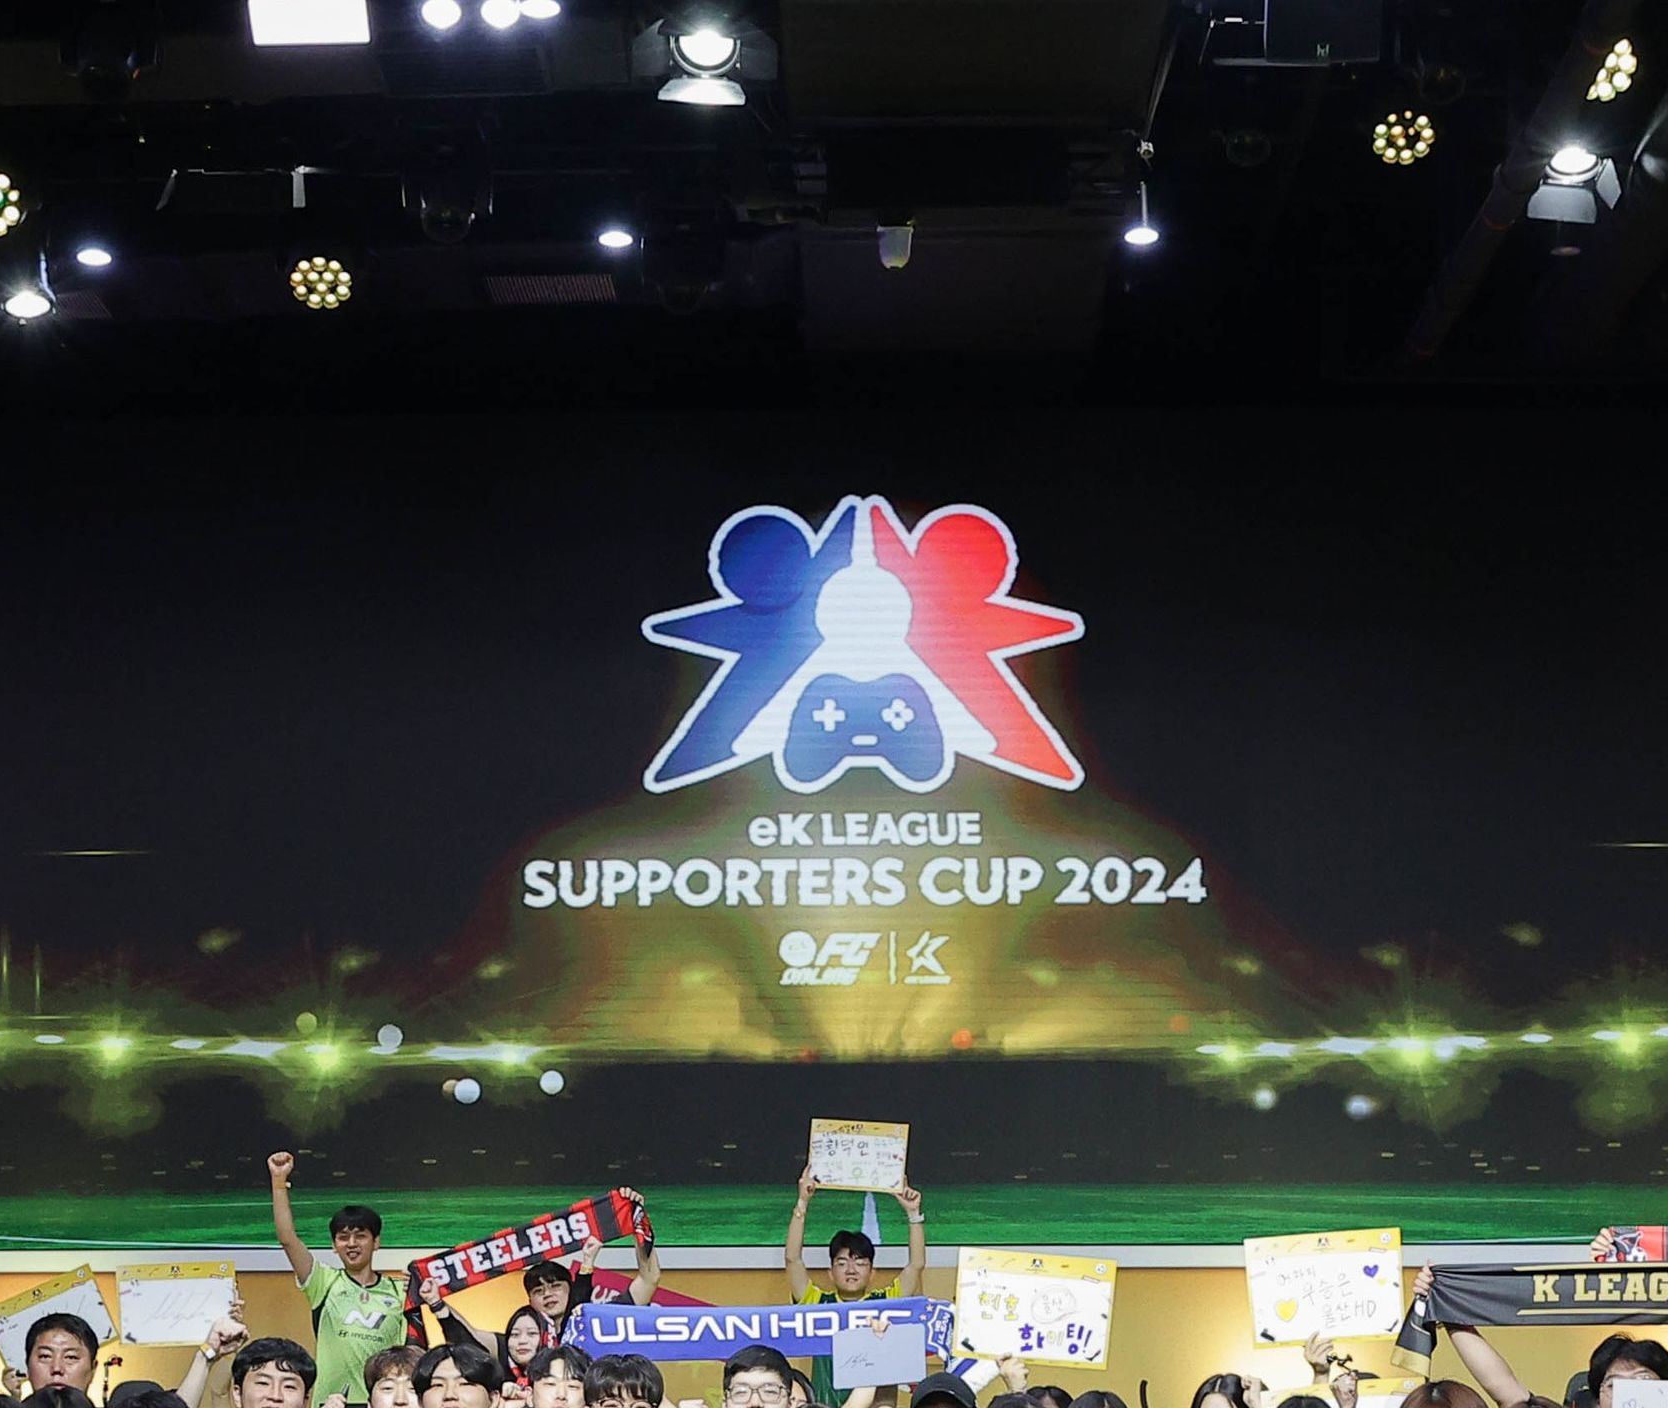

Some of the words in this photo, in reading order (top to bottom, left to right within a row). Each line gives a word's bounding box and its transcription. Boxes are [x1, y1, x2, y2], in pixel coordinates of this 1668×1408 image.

[748, 812, 814, 847] eK
[822, 811, 983, 847] LEAGUE
[522, 858, 906, 908] SUPPORTERS
[919, 857, 1045, 906] CUP
[1054, 856, 1208, 905] 2024
[427, 1211, 593, 1288] STEELERS
[1533, 1271, 1562, 1303] K
[590, 1311, 758, 1344] ULSAN
[769, 1310, 840, 1338] HD
